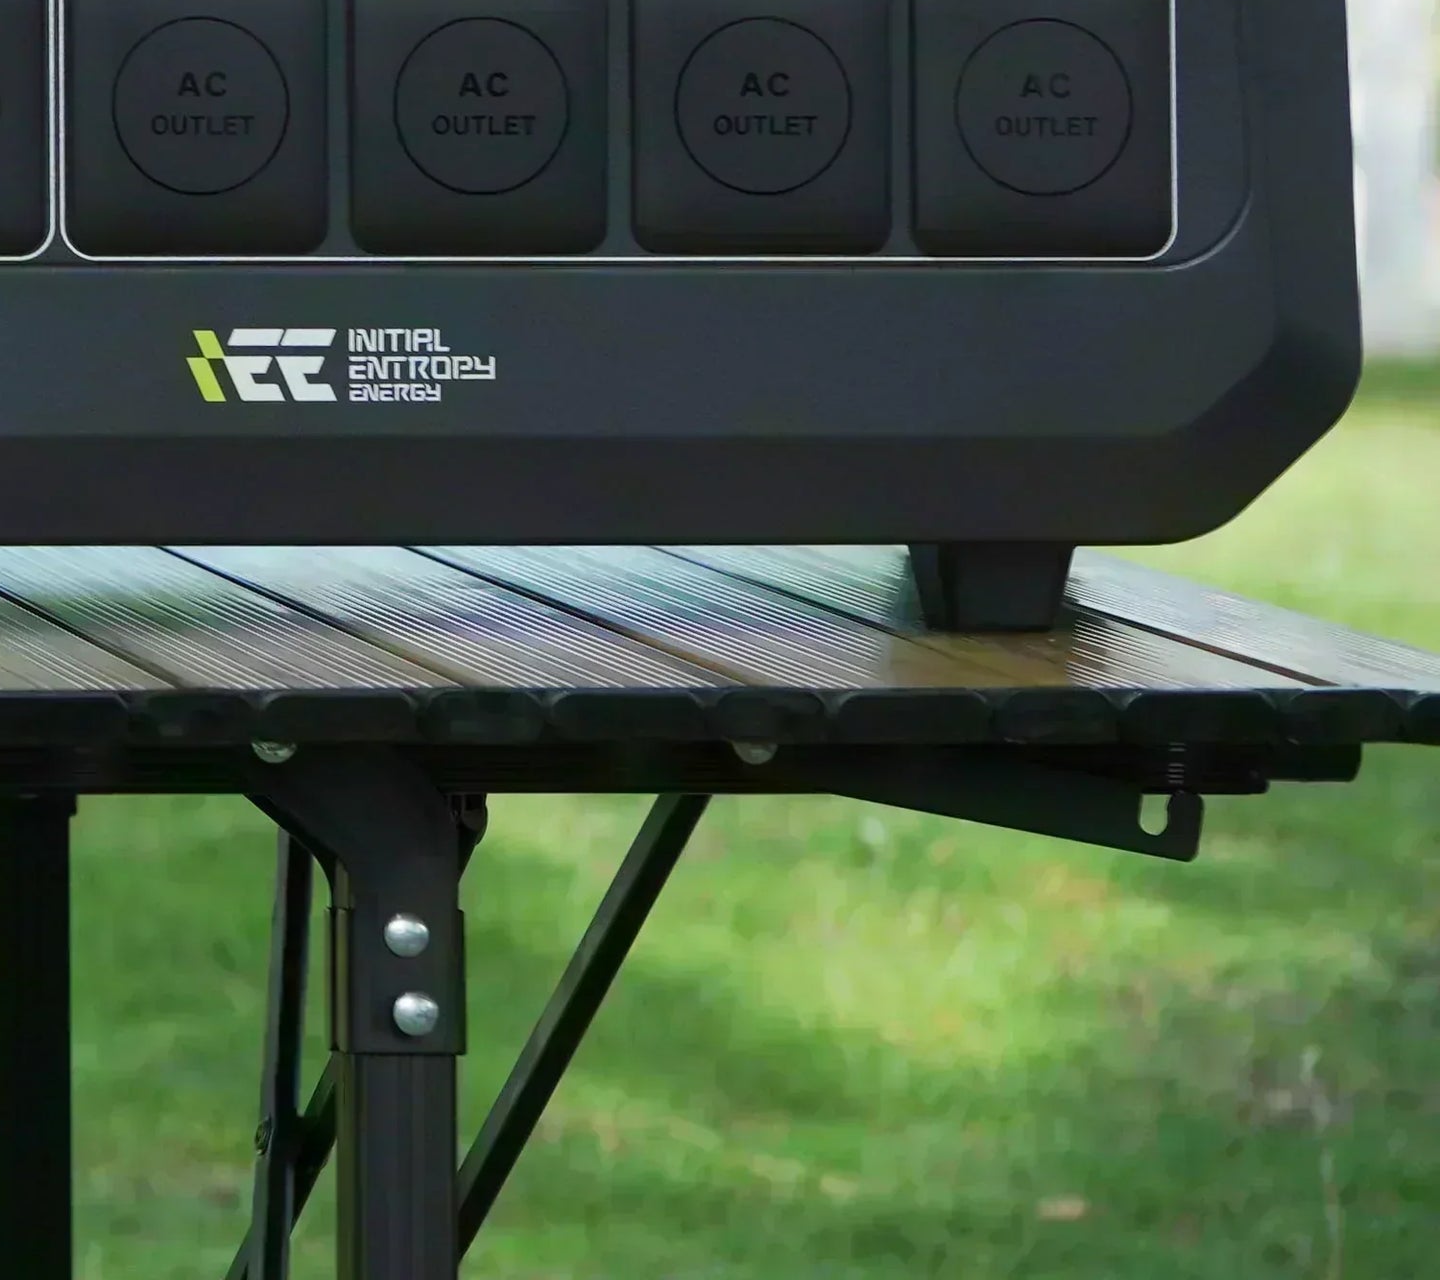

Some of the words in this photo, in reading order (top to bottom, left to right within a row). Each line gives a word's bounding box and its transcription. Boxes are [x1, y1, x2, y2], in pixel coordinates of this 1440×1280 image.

[176, 71, 228, 97] AC
[458, 71, 511, 97] AC
[739, 71, 791, 97] AC
[1019, 72, 1072, 99] AC
[149, 113, 256, 136] OUTLET
[431, 113, 537, 136] OUTLET
[712, 113, 819, 136] OUTLET
[994, 114, 1099, 137] OUTLET
[348, 328, 451, 353] INITIAL
[348, 355, 497, 380] ENTROPY
[348, 383, 442, 402] ENERGY
